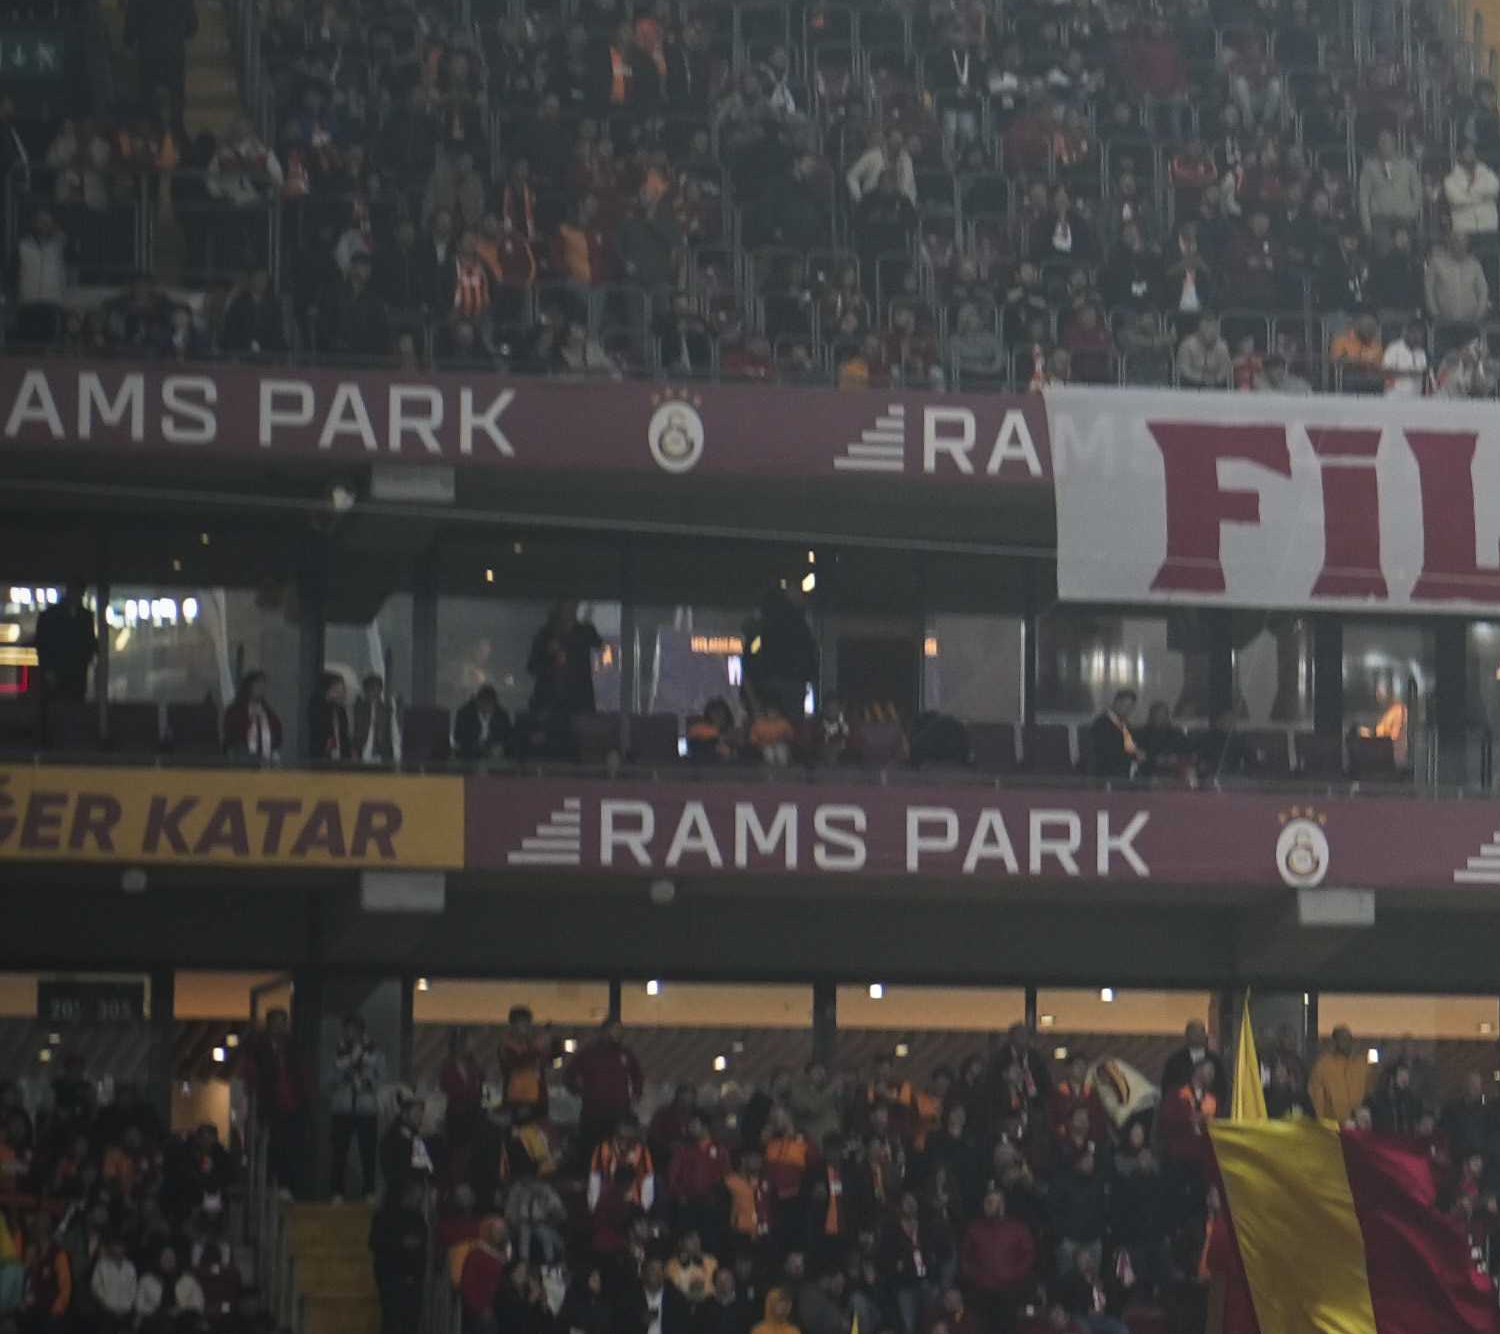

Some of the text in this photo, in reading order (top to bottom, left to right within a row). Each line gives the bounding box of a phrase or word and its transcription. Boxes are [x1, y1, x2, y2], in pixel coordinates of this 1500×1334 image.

[4, 369, 516, 458] AMS PARK
[142, 793, 404, 860] KATAR
[600, 797, 1151, 878] RAMS PARK
